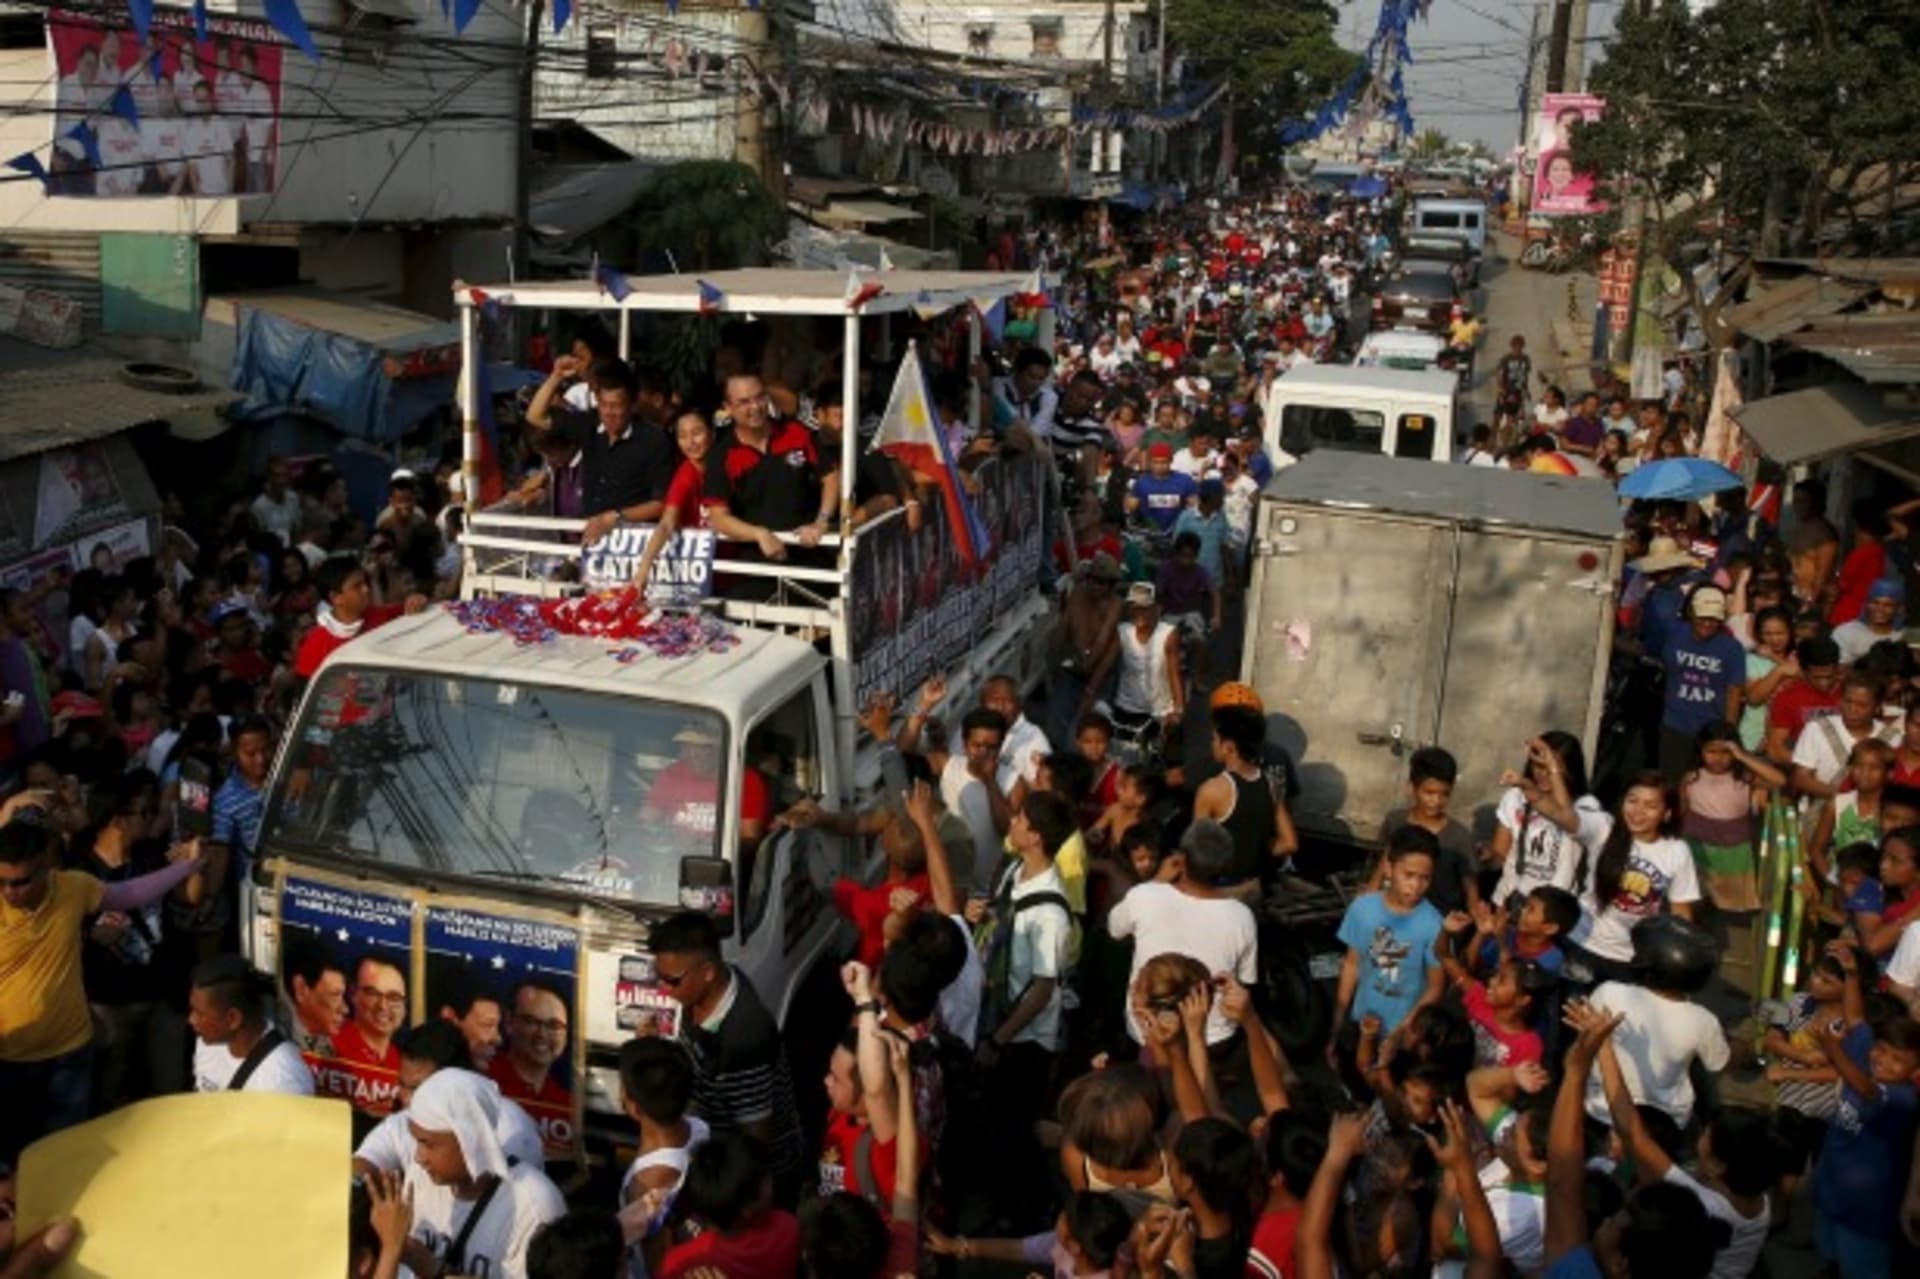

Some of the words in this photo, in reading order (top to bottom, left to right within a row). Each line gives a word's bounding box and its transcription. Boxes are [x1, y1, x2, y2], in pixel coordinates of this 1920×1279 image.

[586, 528, 712, 557] UTRTE
[1676, 650, 1722, 673] VICE
[310, 1064, 400, 1102] YETAN
